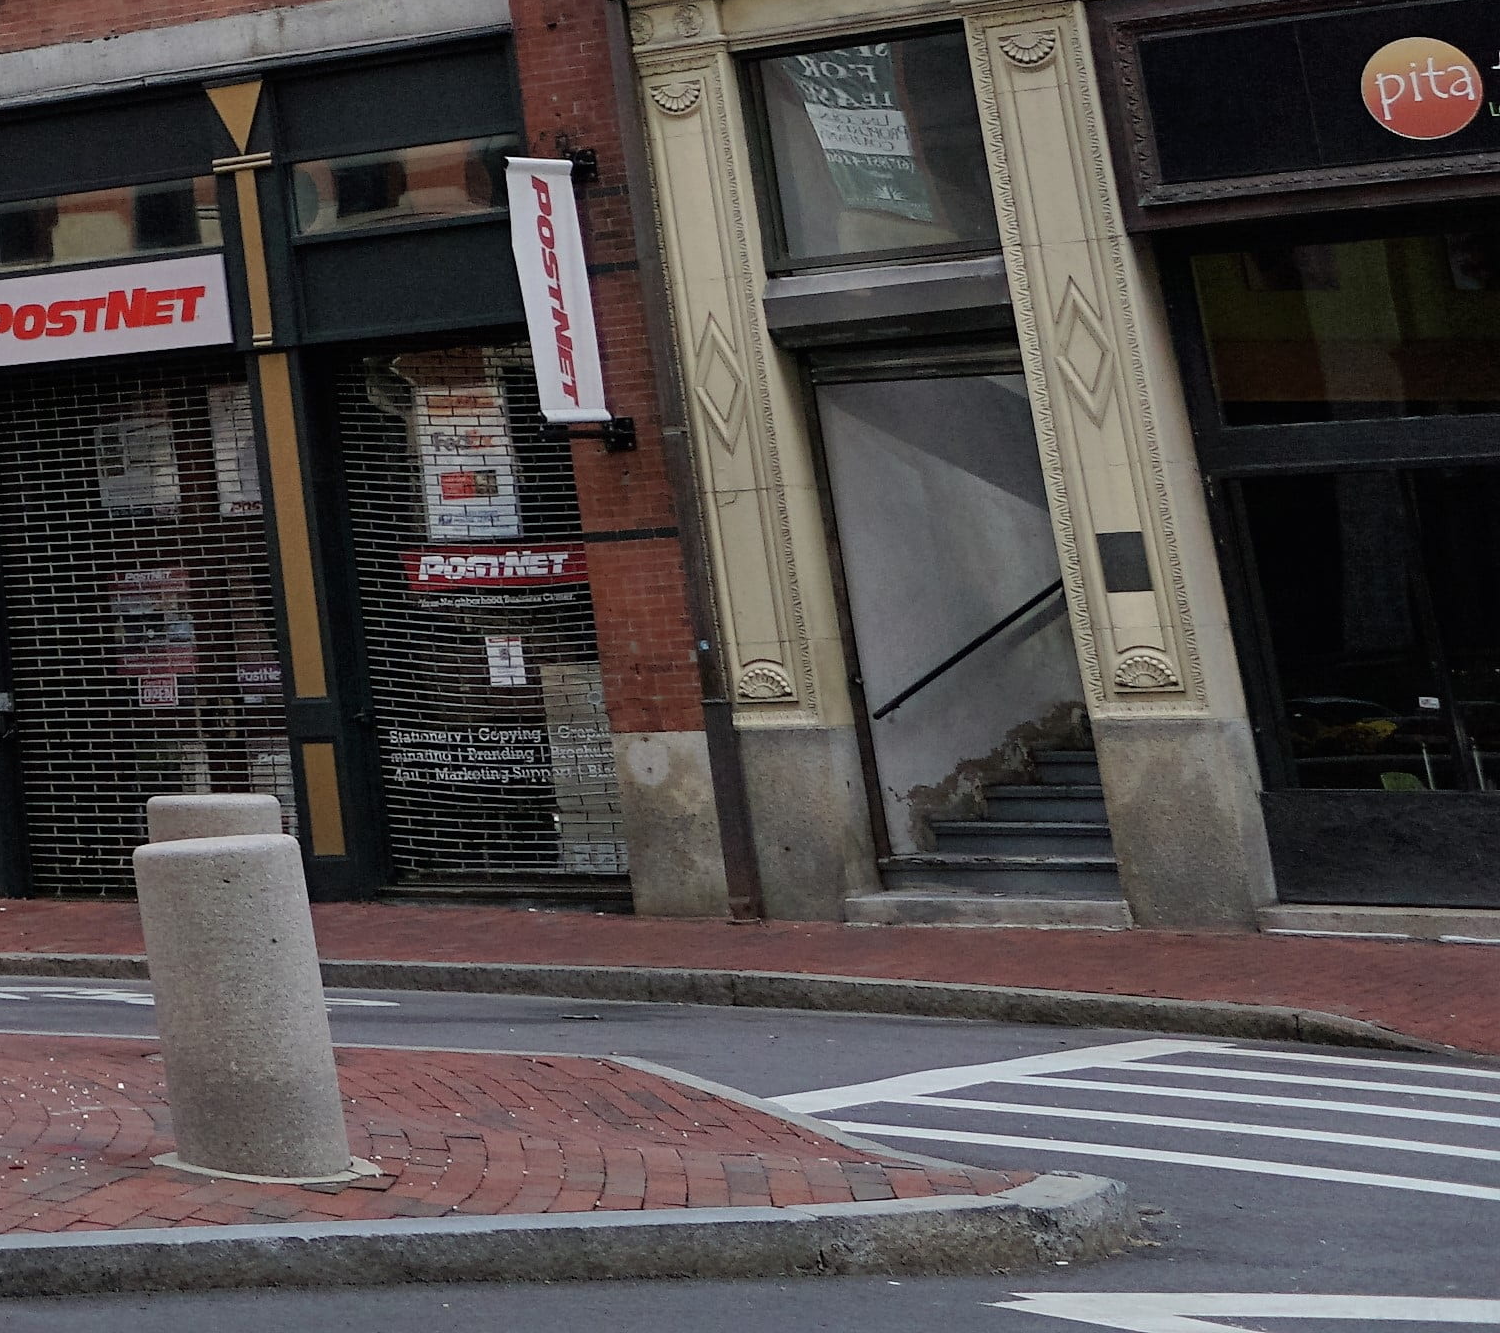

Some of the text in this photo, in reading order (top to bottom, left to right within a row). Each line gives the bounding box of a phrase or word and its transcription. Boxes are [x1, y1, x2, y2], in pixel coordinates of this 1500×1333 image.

[1374, 56, 1476, 121] pita
[478, 727, 542, 743] Copying
[467, 746, 535, 763] Branding
[434, 766, 510, 783] Marketing
